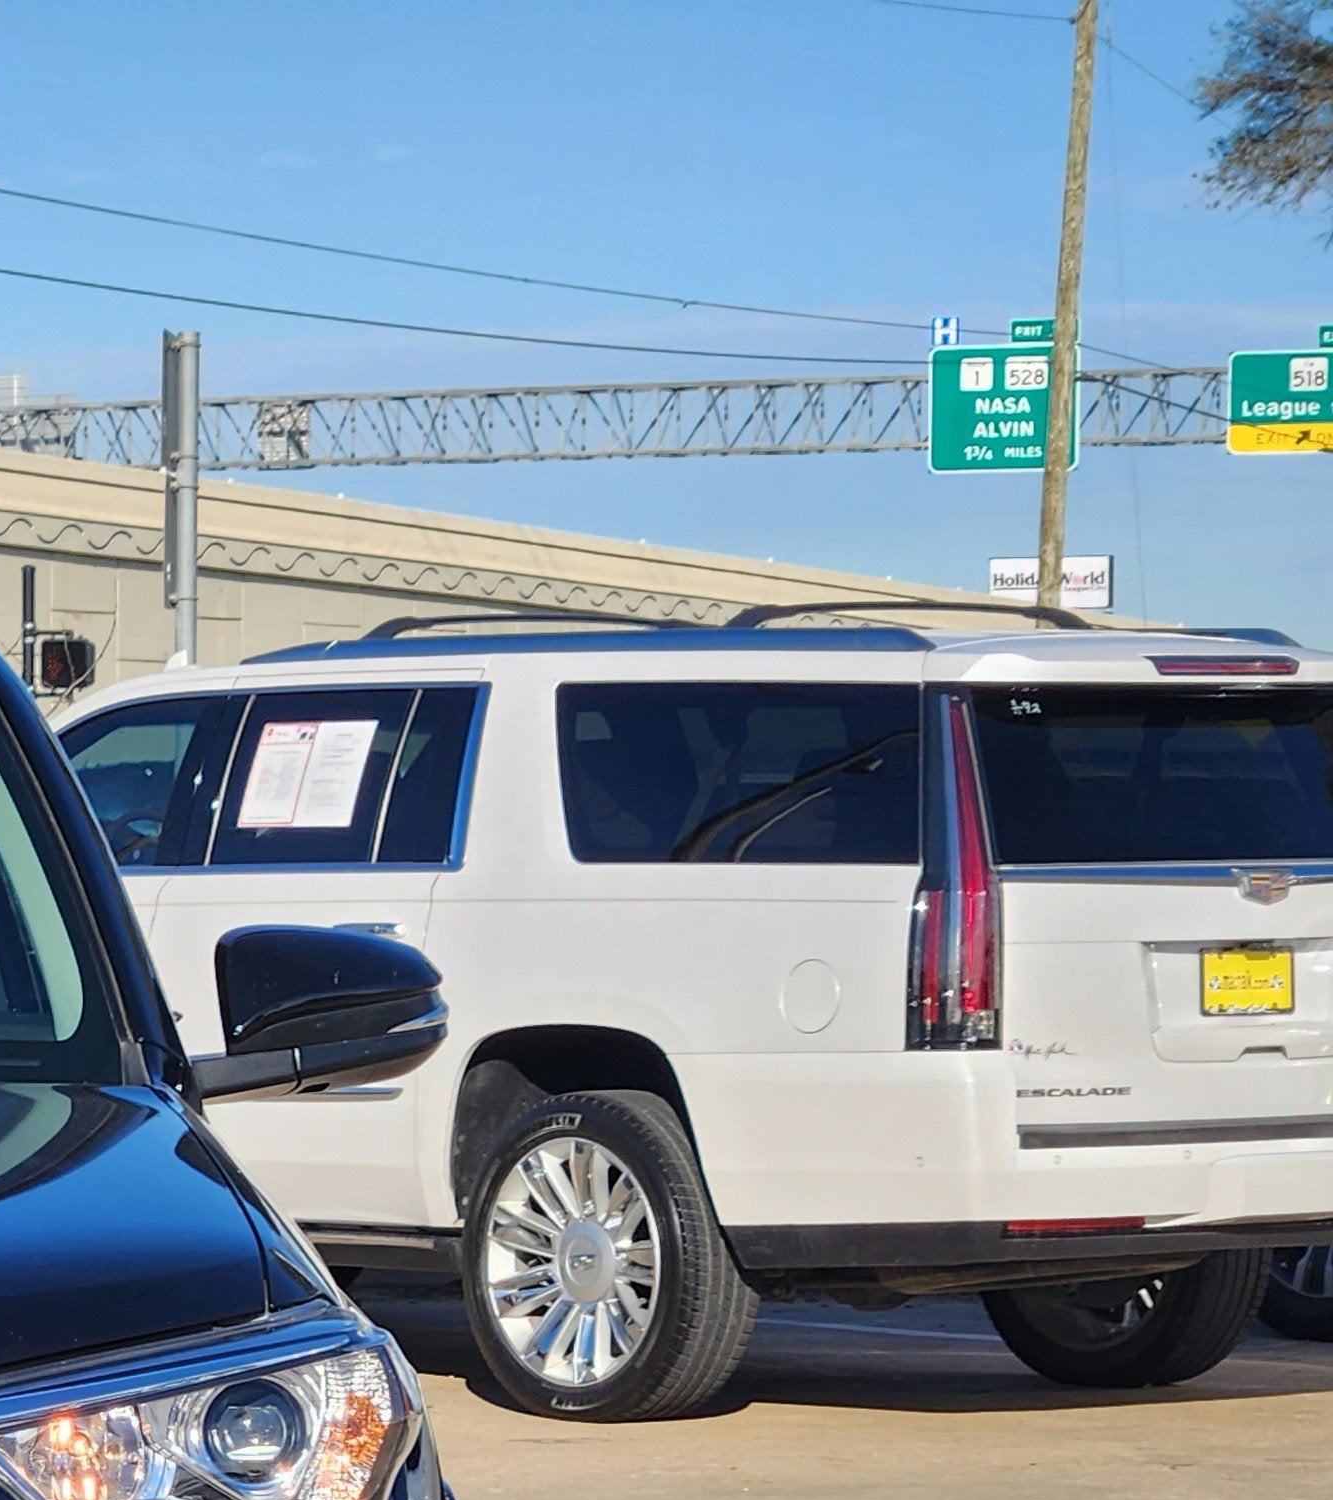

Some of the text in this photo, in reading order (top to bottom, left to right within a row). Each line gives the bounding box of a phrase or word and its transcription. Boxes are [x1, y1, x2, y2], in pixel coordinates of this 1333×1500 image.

[1009, 368, 1046, 387] 528
[1293, 369, 1325, 388] 518
[975, 396, 1032, 415] NASA
[1241, 399, 1321, 420] League
[972, 420, 1035, 439] ALVIN
[1003, 445, 1044, 458] MILES
[1015, 1086, 1132, 1098] ESCALADE
